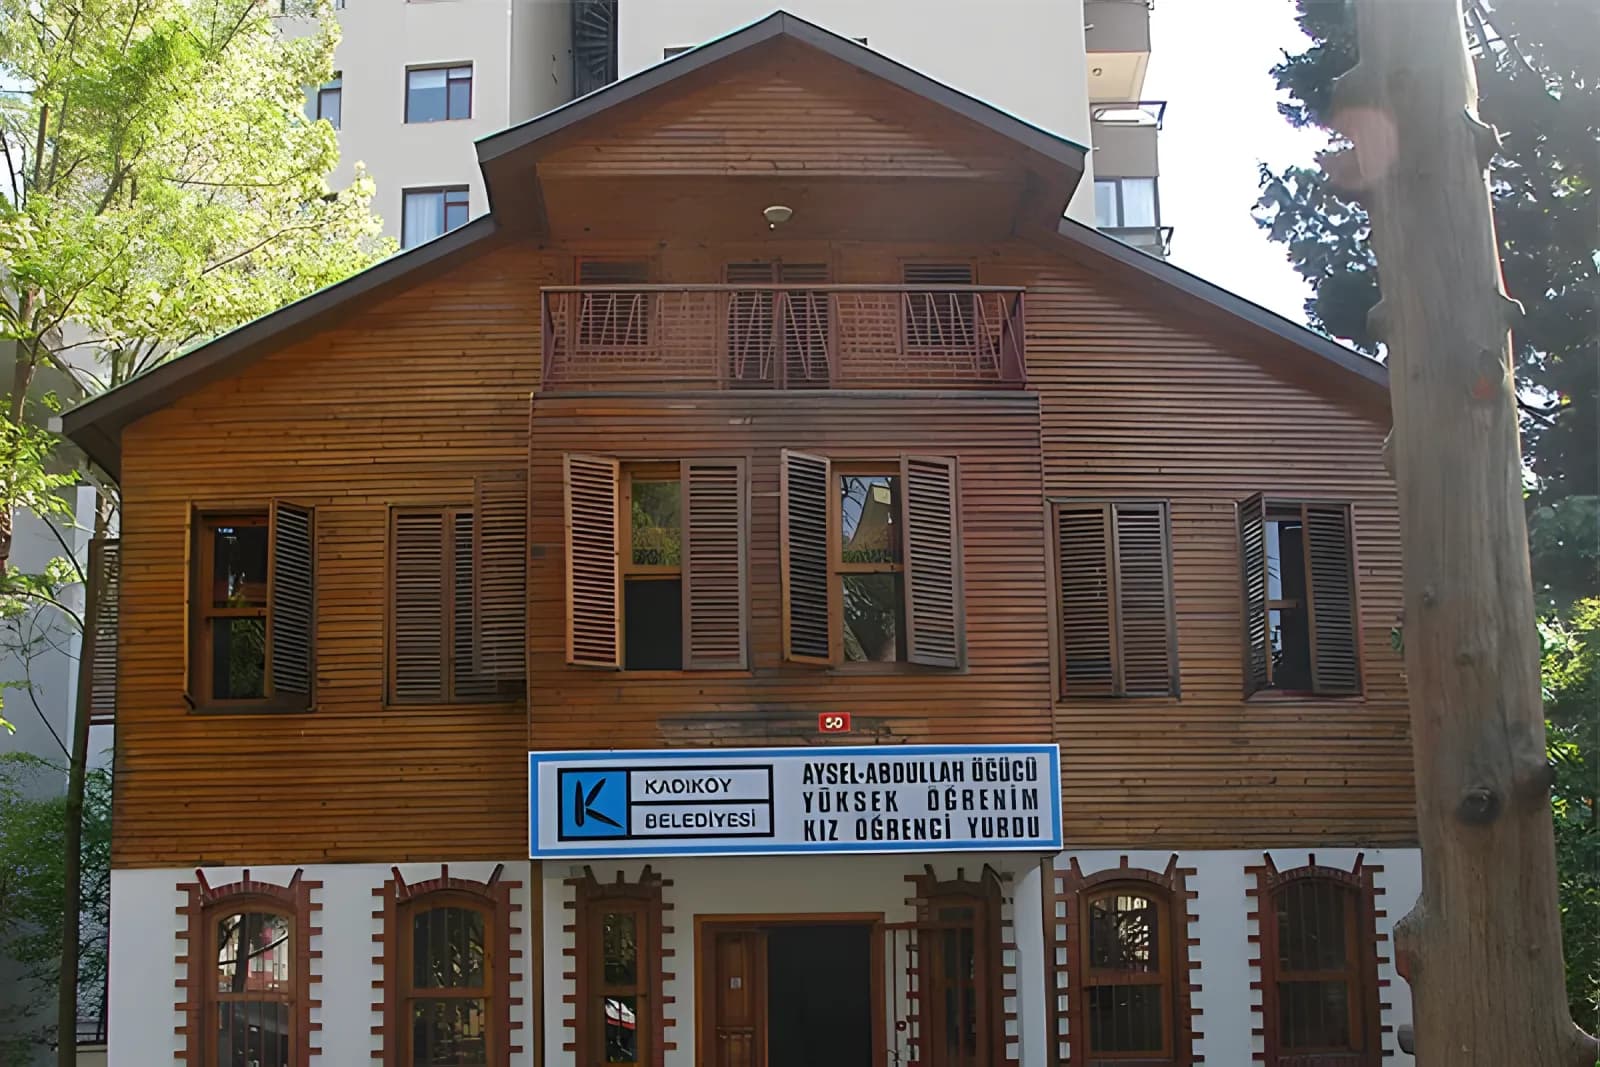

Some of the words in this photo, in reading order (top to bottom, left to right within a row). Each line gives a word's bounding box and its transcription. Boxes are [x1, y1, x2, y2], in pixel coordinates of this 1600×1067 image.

[803, 787, 899, 813] YÜKSEK
[927, 785, 1039, 811] ÖĞRENİM
[645, 808, 756, 829] BELEDİYESİ
[804, 820, 839, 841] KIZ
[967, 816, 1040, 838] YURDU
